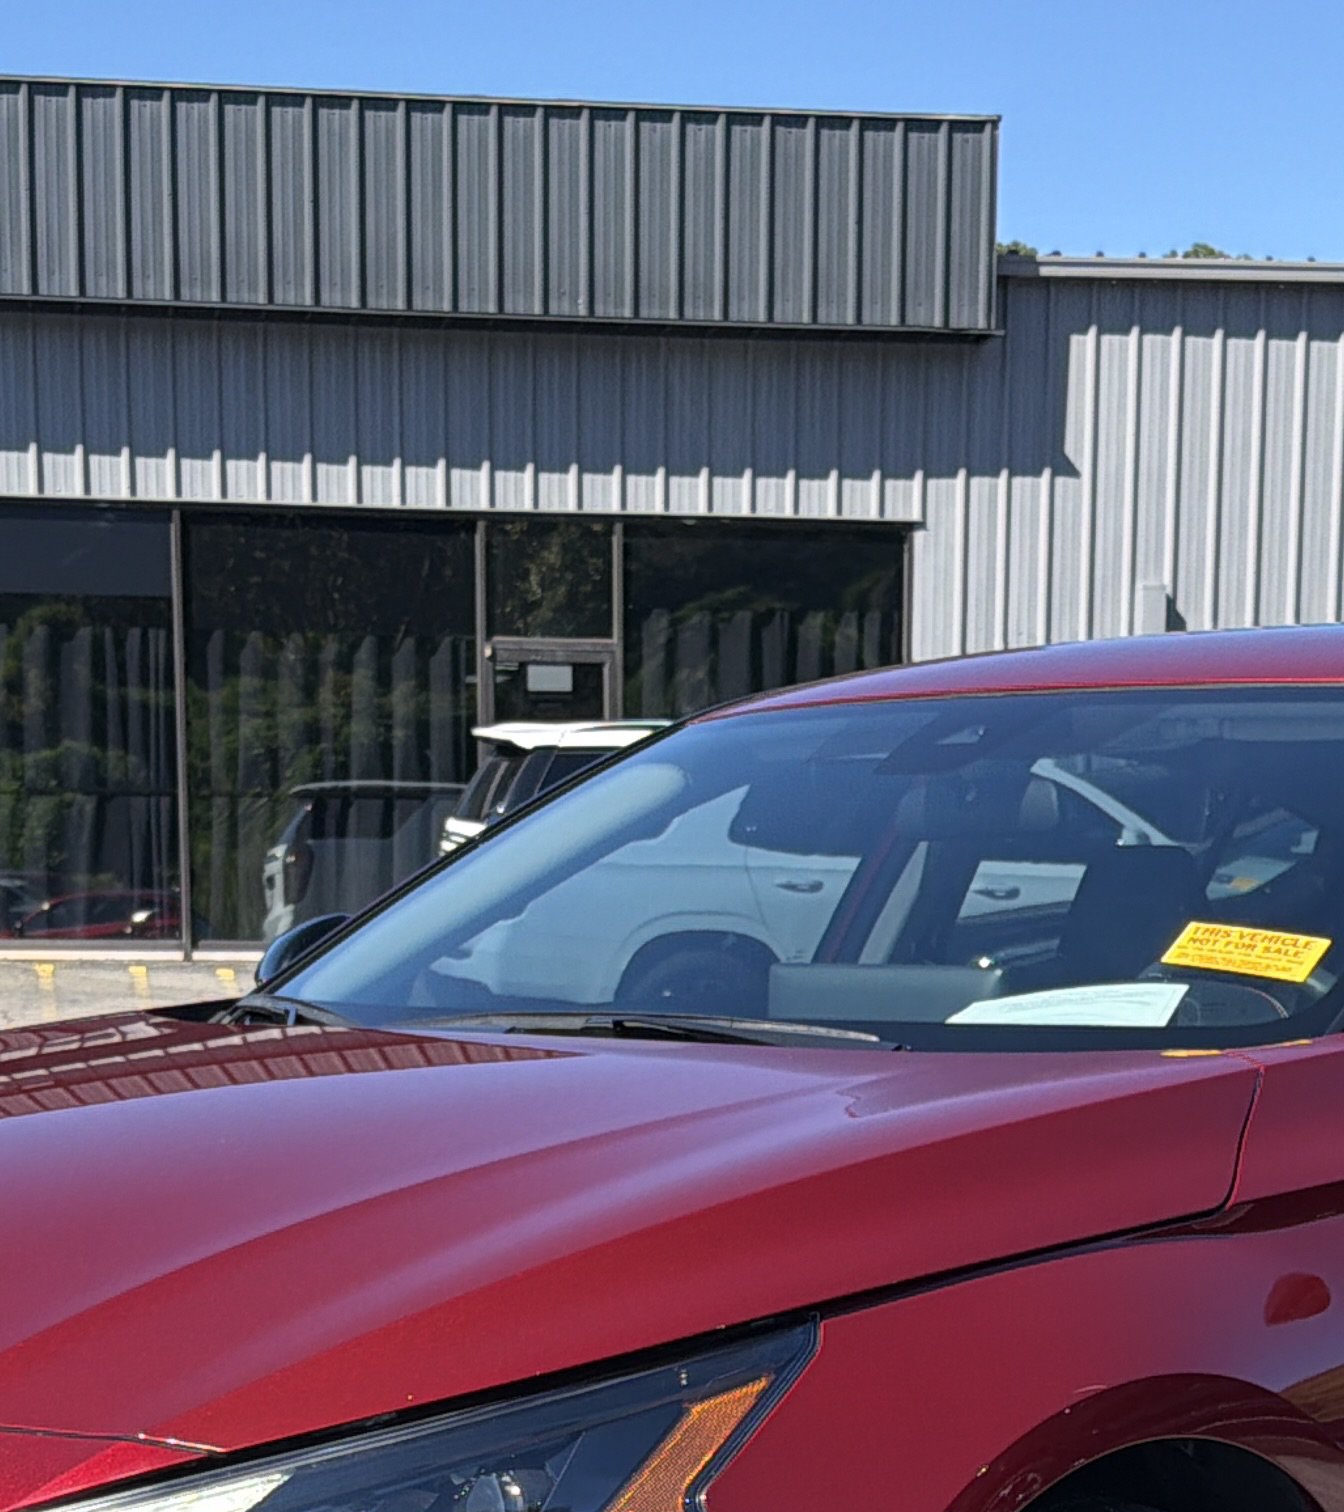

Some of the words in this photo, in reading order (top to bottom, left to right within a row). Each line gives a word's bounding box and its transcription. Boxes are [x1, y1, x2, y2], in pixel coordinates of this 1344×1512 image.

[1187, 937, 1218, 948] NOT
[1223, 940, 1258, 952] FOR
[1261, 945, 1305, 959] SALE
[1192, 926, 1233, 939] THIS
[1238, 930, 1317, 951] VEHICLE
